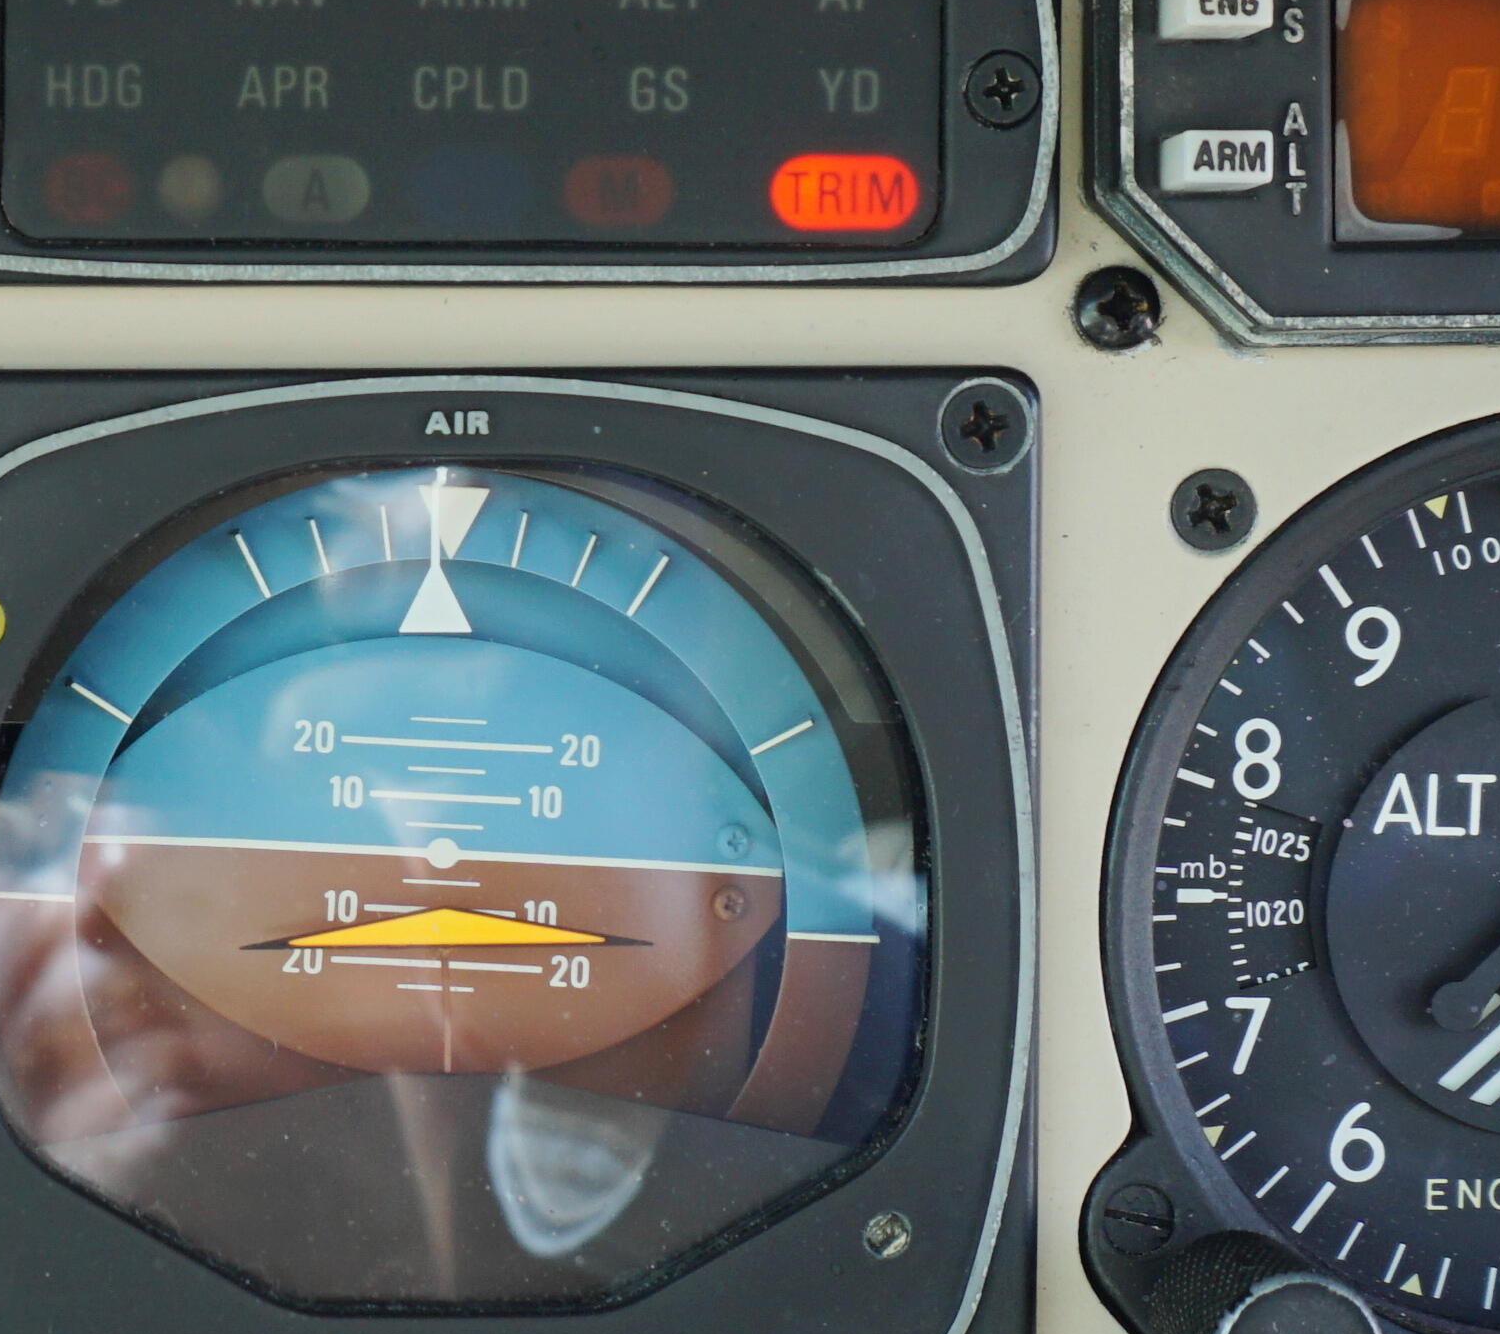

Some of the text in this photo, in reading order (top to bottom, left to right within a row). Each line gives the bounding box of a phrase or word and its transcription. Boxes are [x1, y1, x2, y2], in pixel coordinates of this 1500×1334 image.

[45, 65, 881, 113] HDG APR CPLD GS YD
[1193, 140, 1269, 174] ARM
[784, 169, 908, 216] TRIM
[424, 409, 489, 437] AIR
[1344, 604, 1403, 687] 9
[293, 718, 336, 756] 20
[559, 732, 601, 771] 20
[1231, 716, 1283, 801] 8
[329, 774, 365, 810] 10
[527, 783, 563, 820] 10
[1372, 772, 1497, 838] ALT
[1251, 825, 1312, 863] 1025
[1179, 853, 1227, 880] mb
[324, 889, 359, 924] 10
[1245, 898, 1305, 929] 1020
[548, 953, 591, 990] 20
[1223, 995, 1273, 1075] 7
[1329, 1101, 1387, 1184] 6
